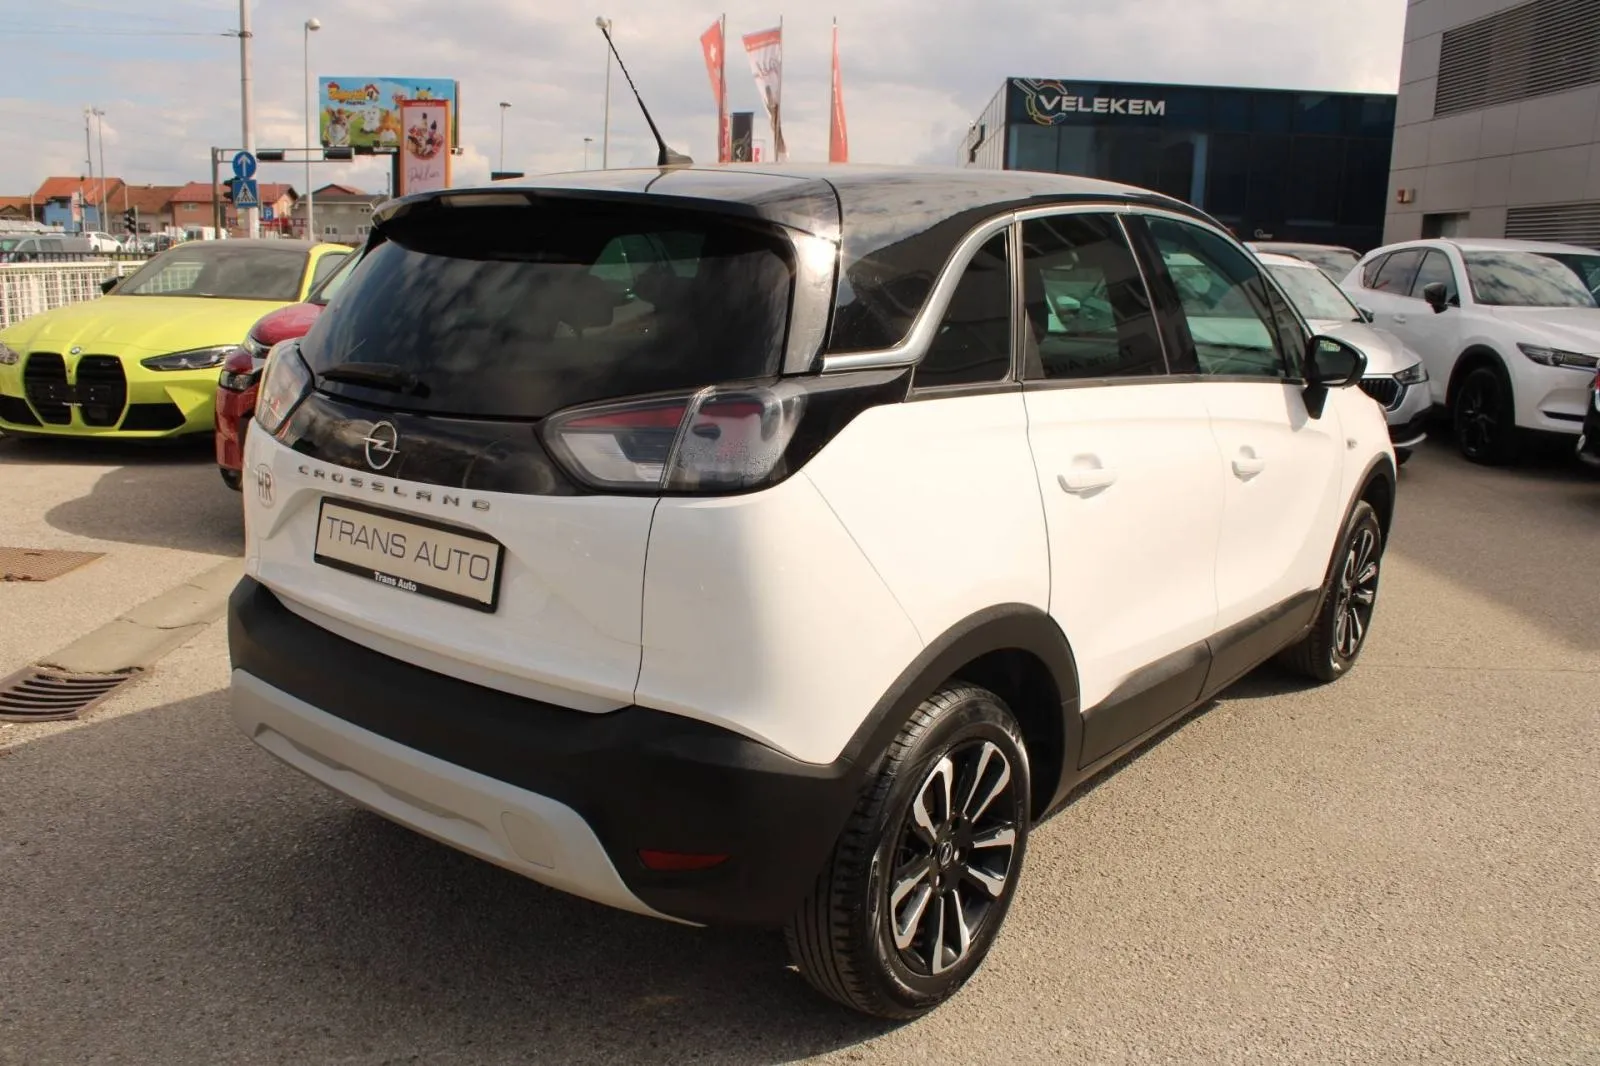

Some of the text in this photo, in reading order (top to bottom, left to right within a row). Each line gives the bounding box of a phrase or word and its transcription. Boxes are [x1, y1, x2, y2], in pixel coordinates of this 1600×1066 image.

[1038, 94, 1166, 116] VELEKEM
[265, 208, 272, 219] P
[257, 470, 273, 503] HR
[298, 464, 491, 512] CROSSLAND
[326, 515, 491, 582] TRANS AUTO
[374, 570, 417, 592] Trans Auto
